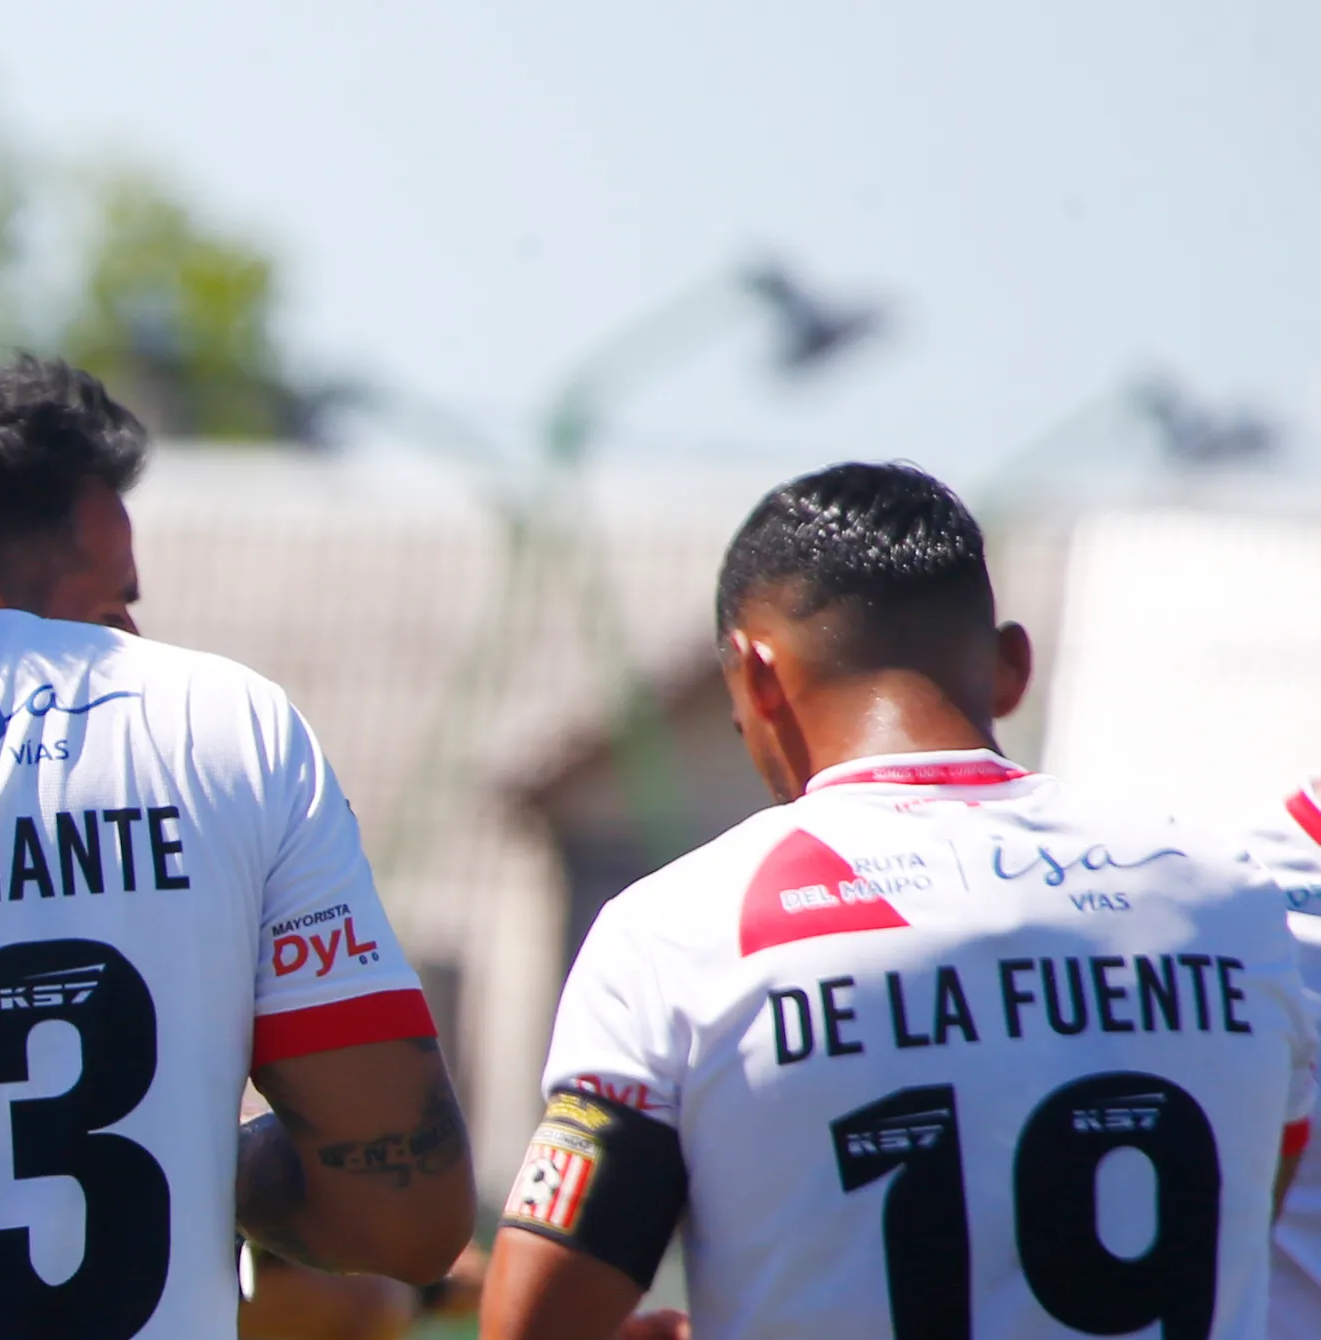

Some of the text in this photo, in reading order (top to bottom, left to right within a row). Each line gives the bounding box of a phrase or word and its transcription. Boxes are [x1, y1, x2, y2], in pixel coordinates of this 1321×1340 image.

[8, 739, 70, 765] VÍAS
[853, 851, 927, 873] RUTA
[783, 874, 933, 908] DEL MAIPO
[271, 903, 352, 937] MAYORISTA
[0, 980, 100, 1011] KS7
[767, 952, 1254, 1065] DE LA FUENTE
